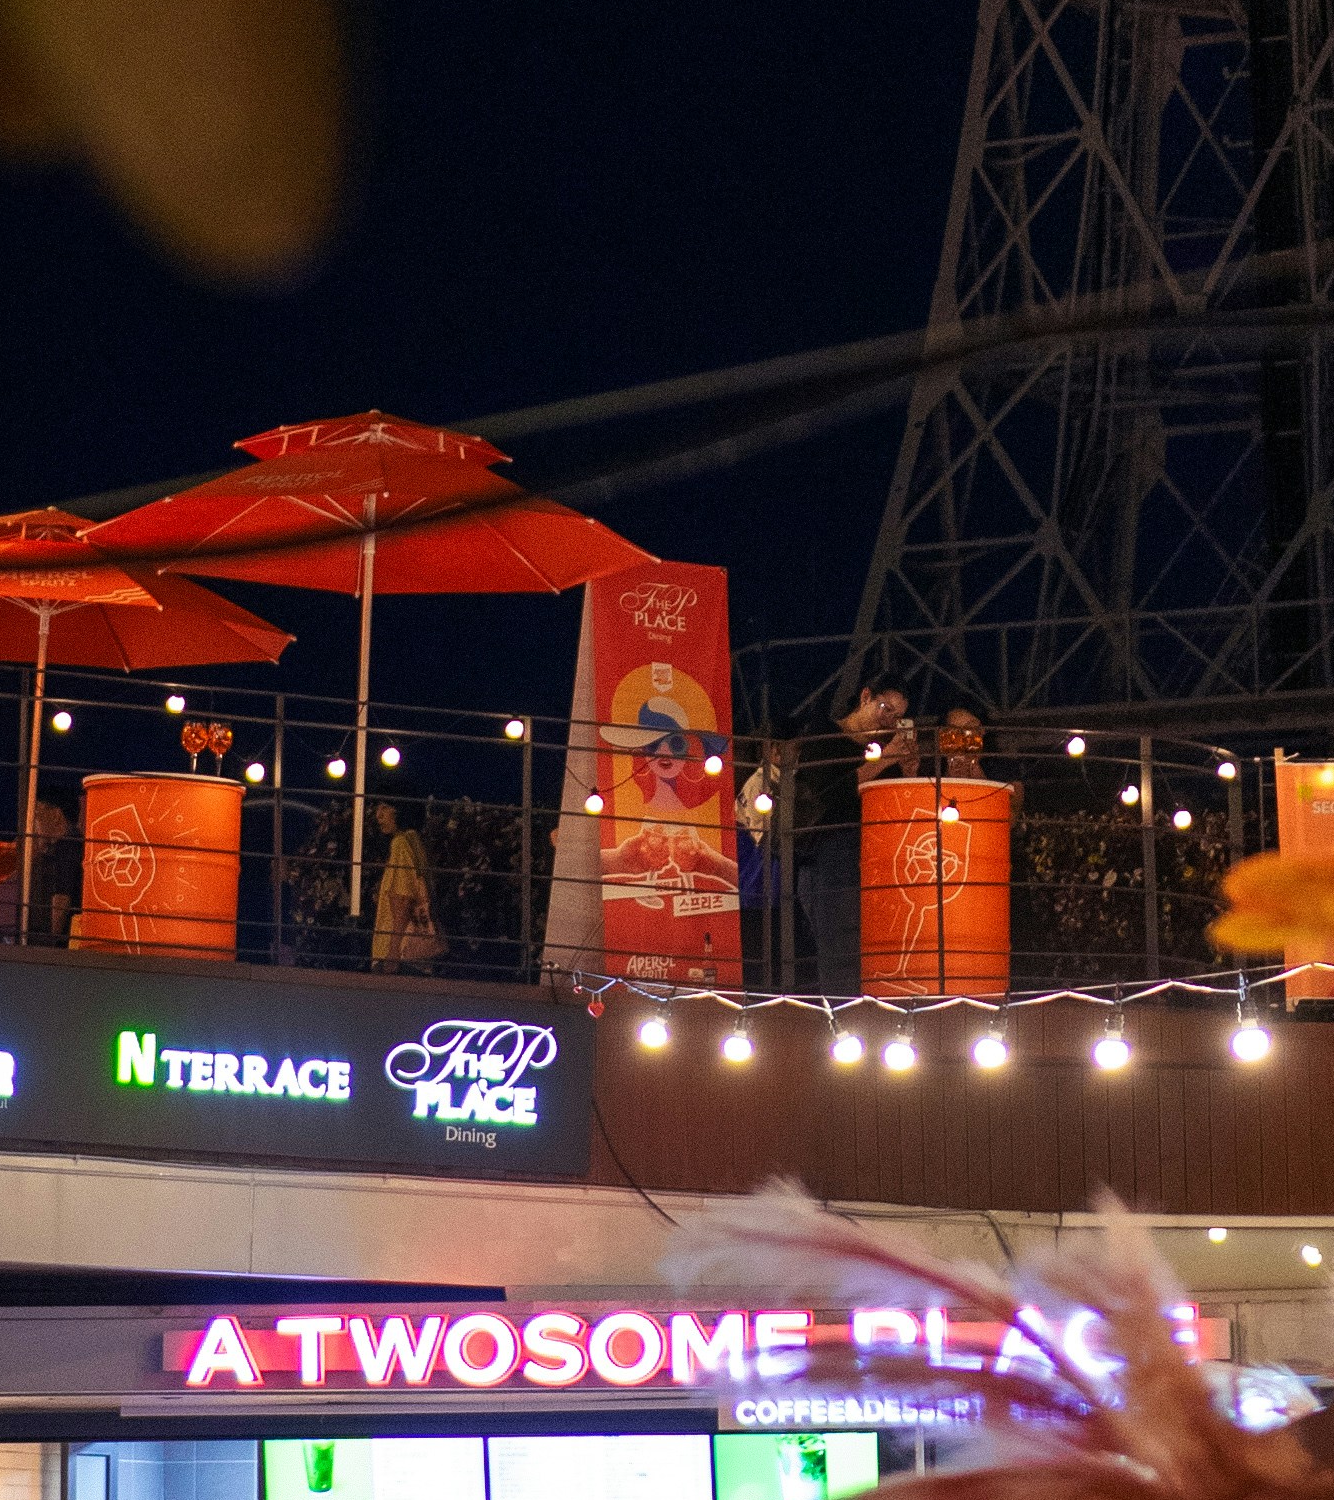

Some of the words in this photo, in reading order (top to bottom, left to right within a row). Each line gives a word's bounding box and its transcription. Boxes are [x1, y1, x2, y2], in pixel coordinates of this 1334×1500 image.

[634, 611, 687, 632] PLACE
[116, 1030, 157, 1085] N
[160, 1049, 352, 1099] TERRACE
[412, 1078, 539, 1126] PLACE
[445, 1125, 498, 1149] Dining
[187, 1315, 265, 1386] A
[275, 1308, 814, 1388] TWOSOME
